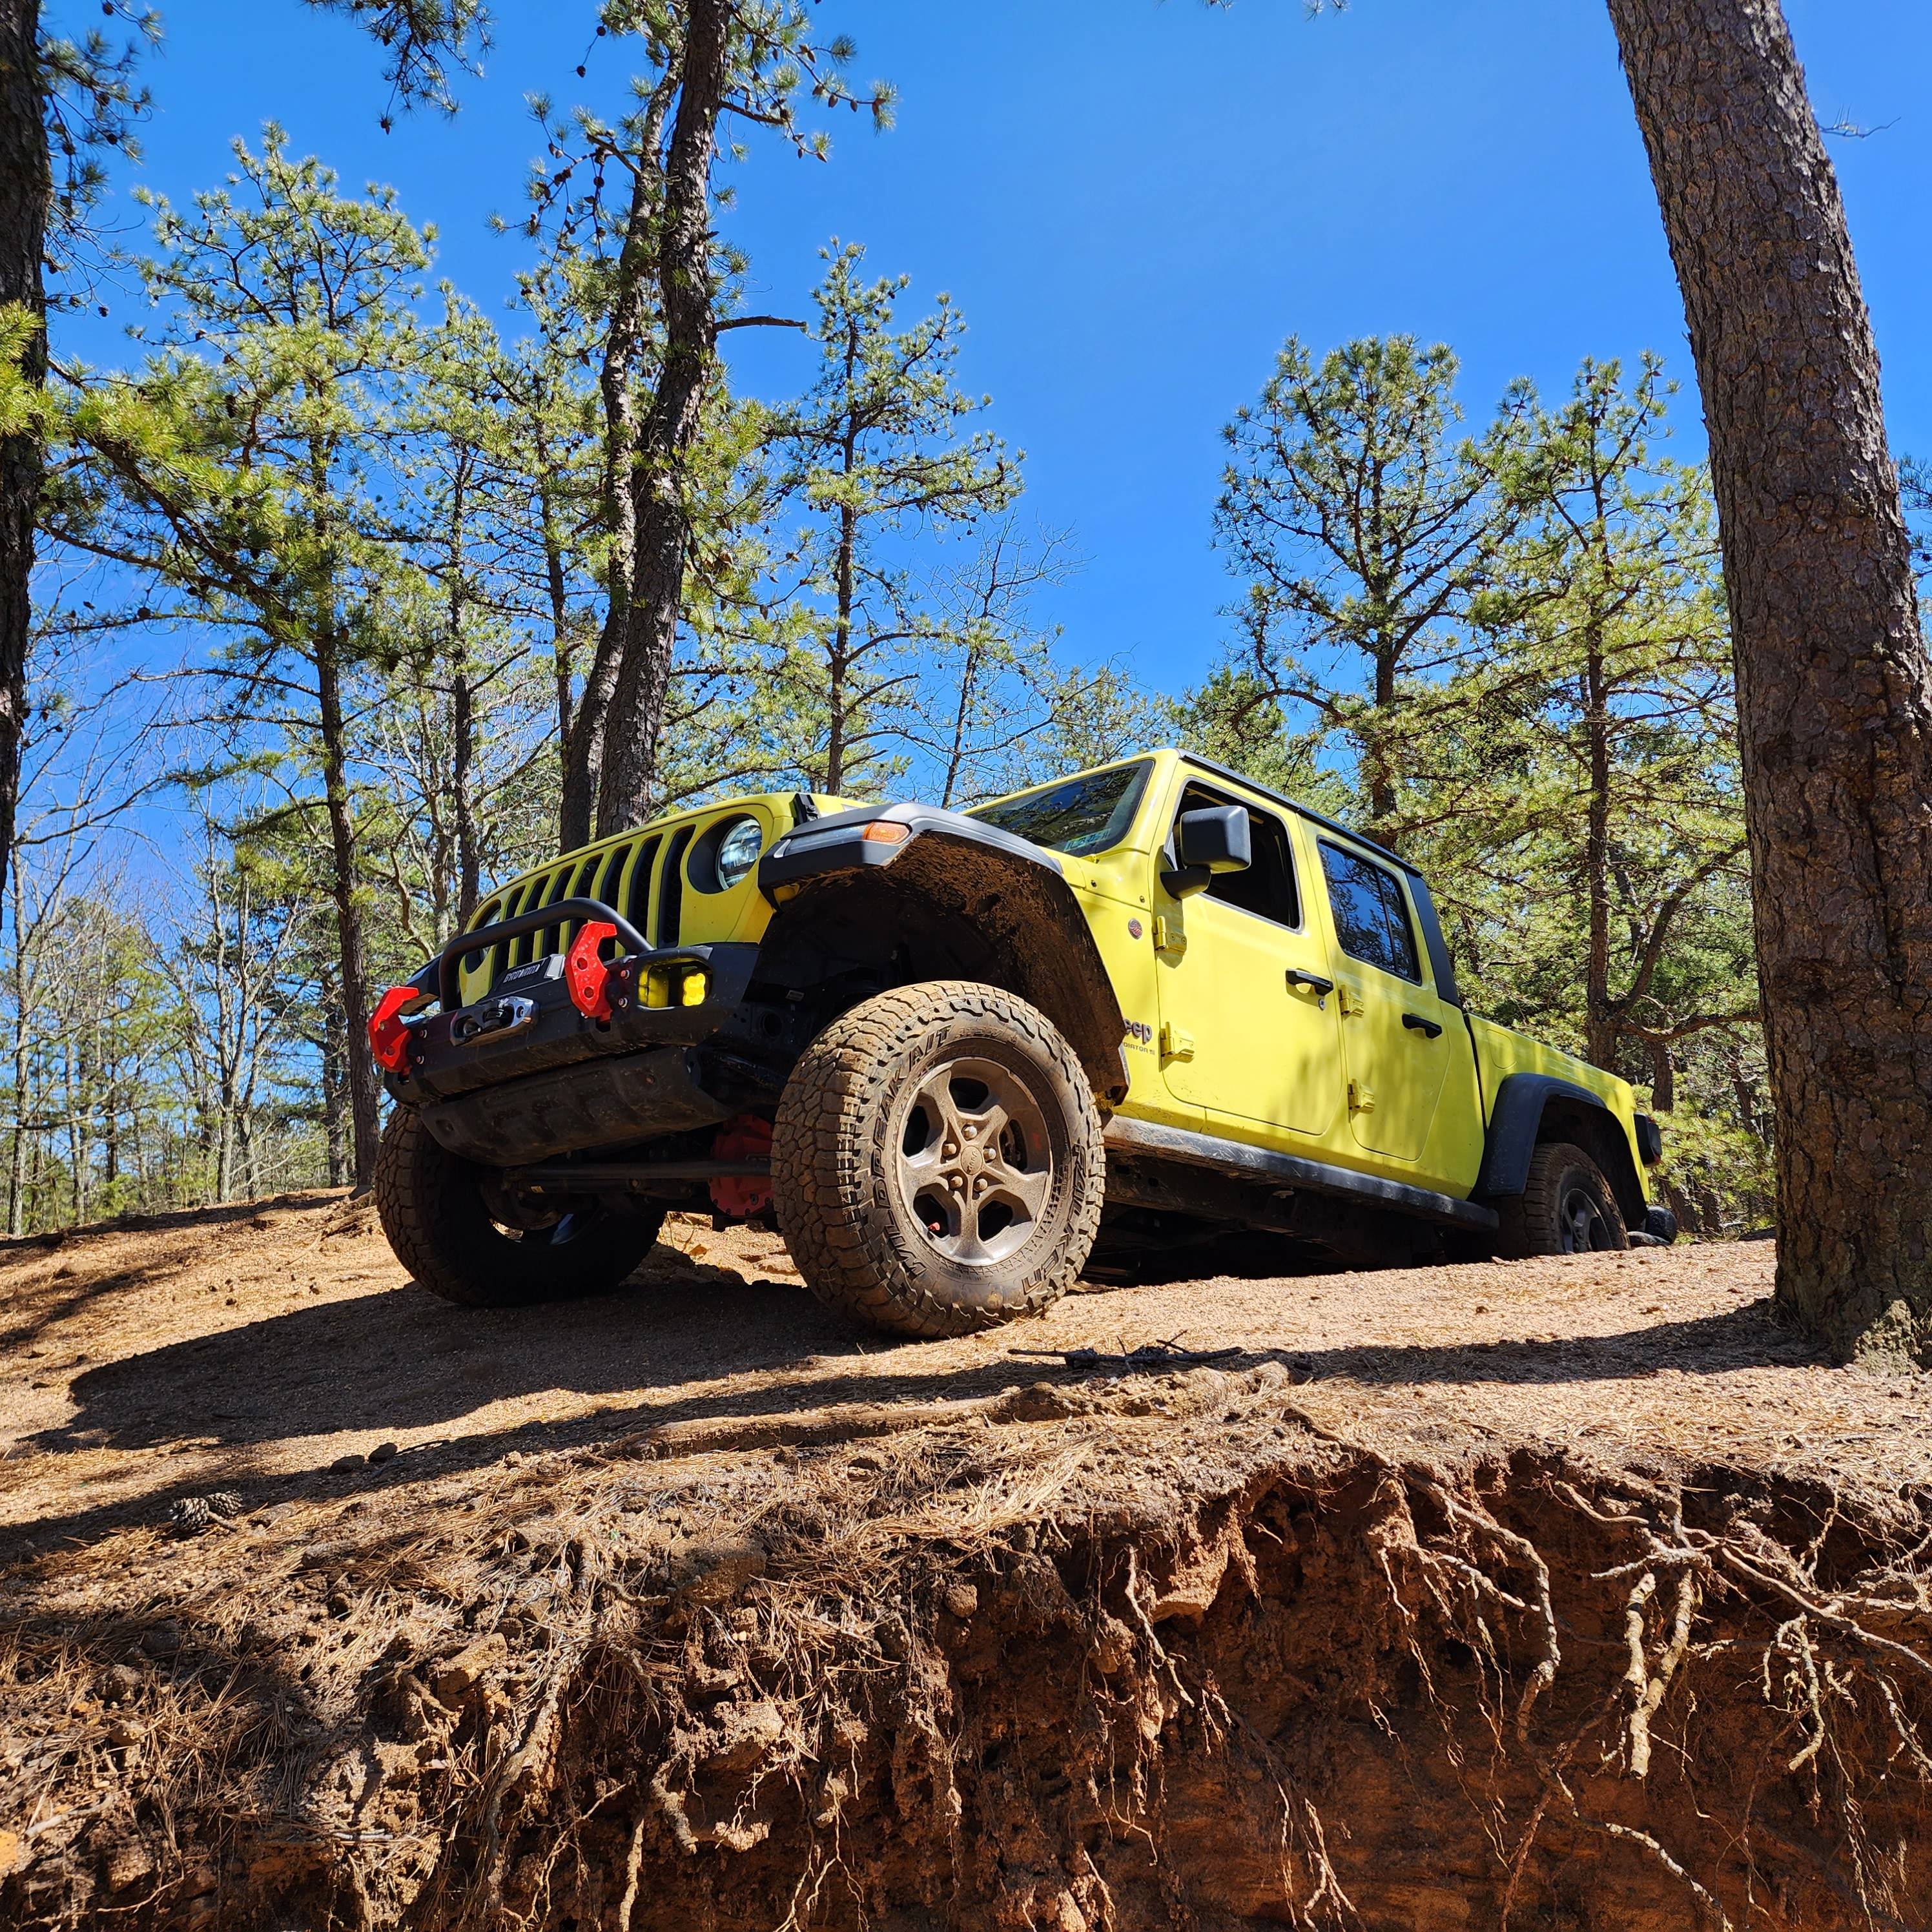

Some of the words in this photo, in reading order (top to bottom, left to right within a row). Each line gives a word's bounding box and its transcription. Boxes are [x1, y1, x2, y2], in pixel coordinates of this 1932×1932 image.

[1124, 1020, 1152, 1044] eep
[1124, 1042, 1148, 1053] DIATOR
[872, 1065, 927, 1277] WILDPEAK
[909, 1025, 952, 1072] A/T
[1022, 1142, 1087, 1295] FALKEN
